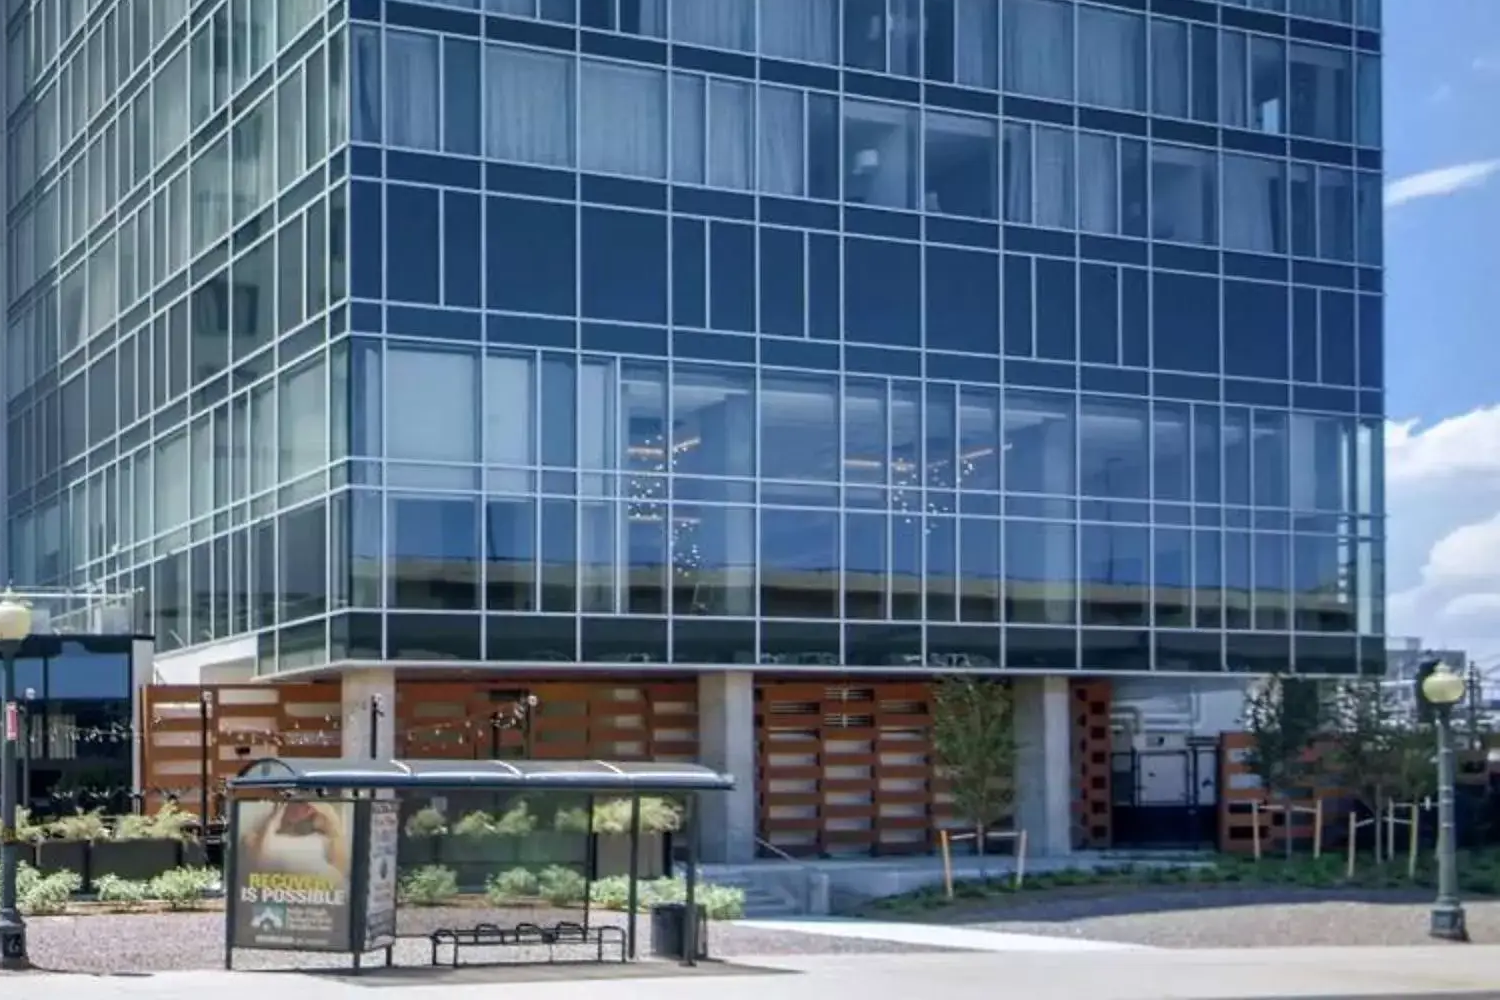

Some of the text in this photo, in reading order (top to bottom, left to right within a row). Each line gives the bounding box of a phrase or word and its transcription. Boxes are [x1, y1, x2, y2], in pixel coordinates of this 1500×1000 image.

[249, 873, 335, 890] RECOVERY
[241, 887, 346, 905] IS POSSIBLE
